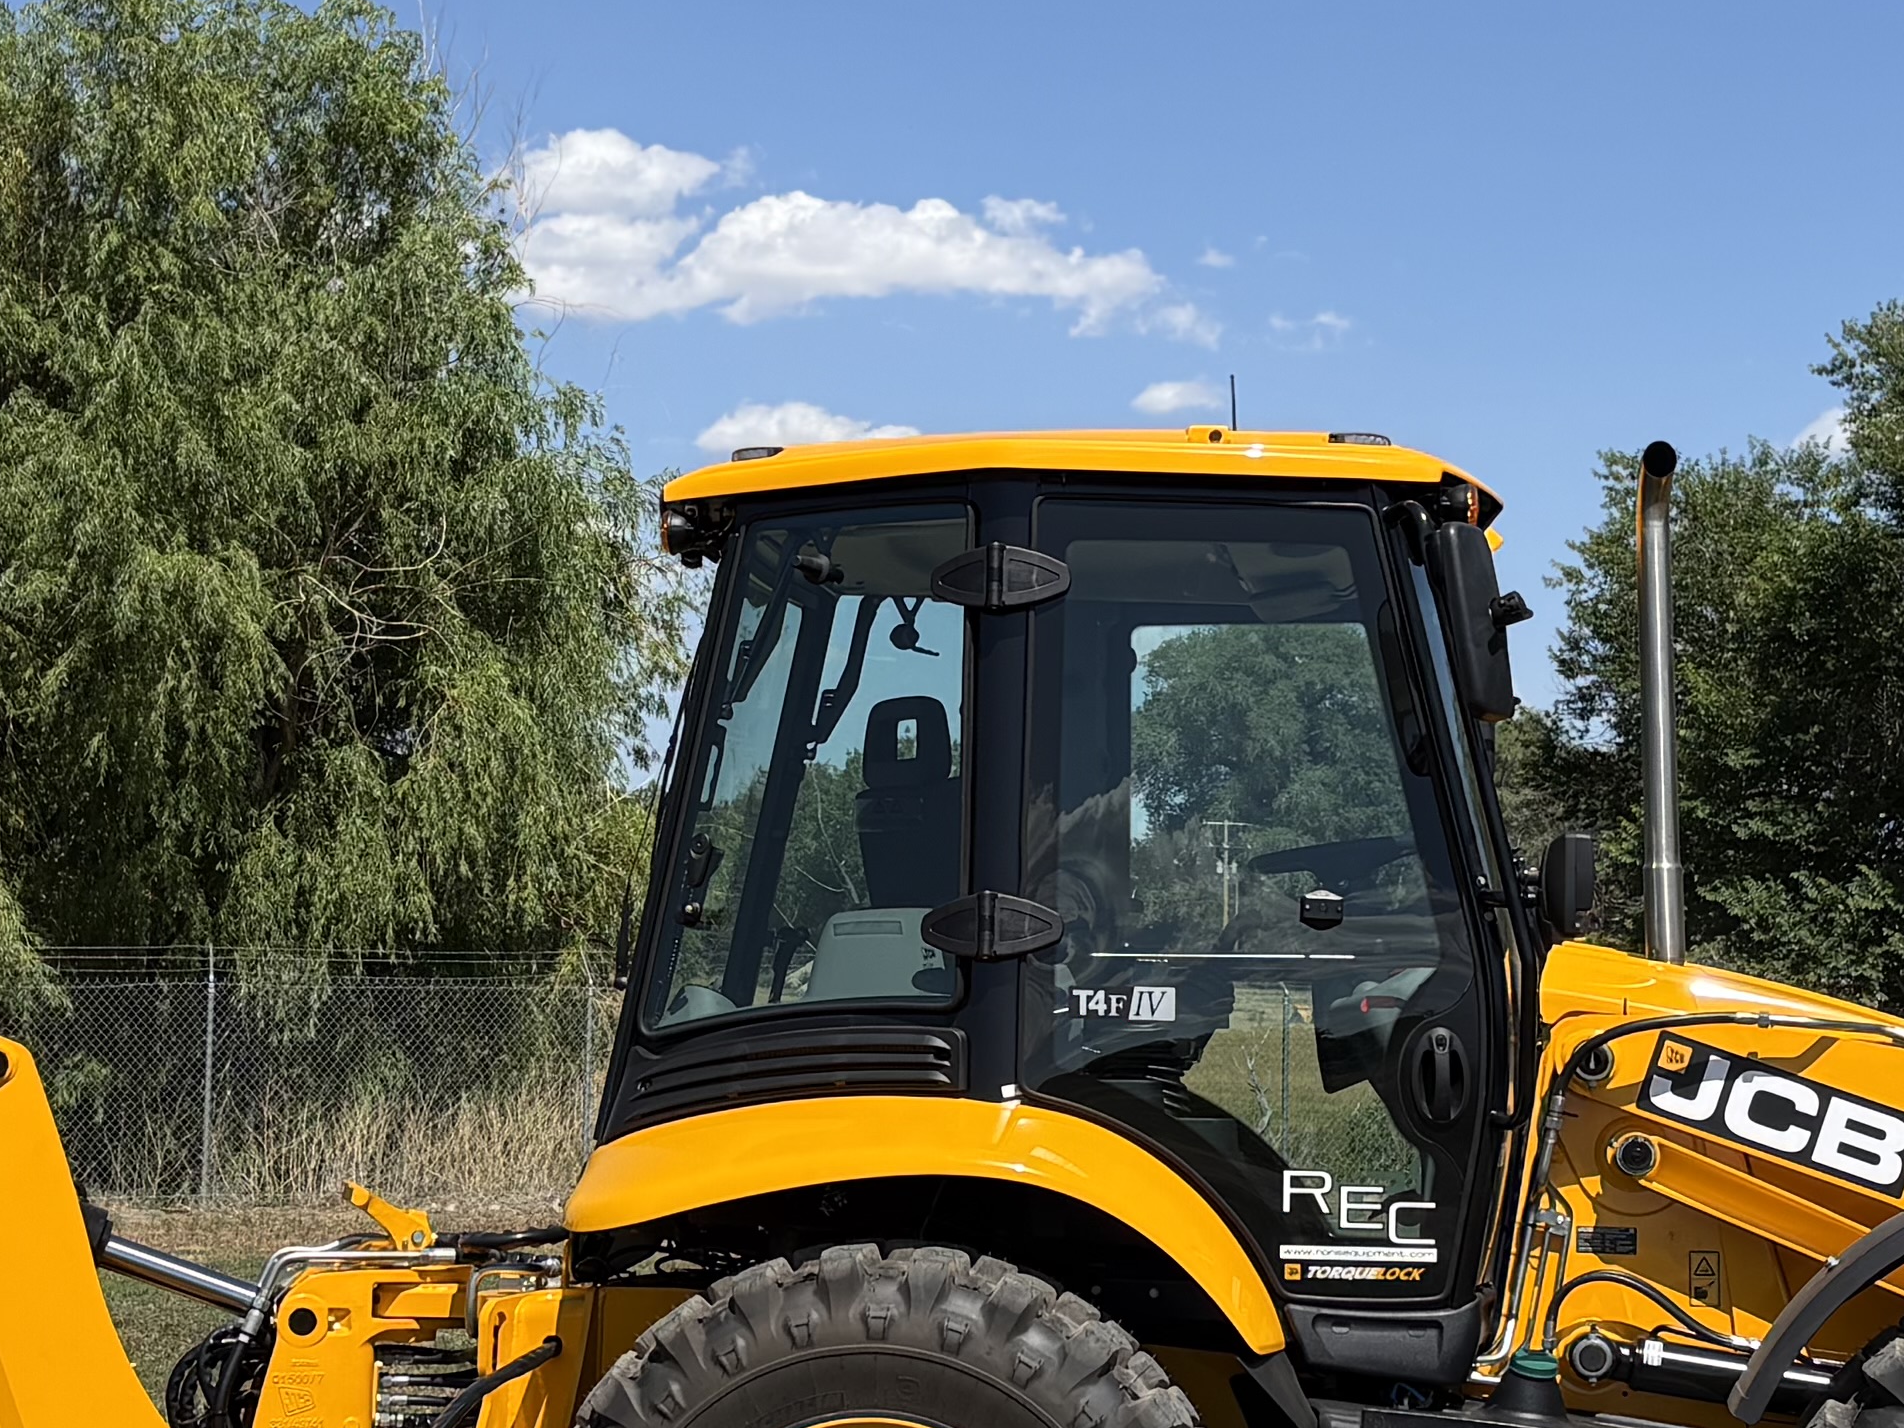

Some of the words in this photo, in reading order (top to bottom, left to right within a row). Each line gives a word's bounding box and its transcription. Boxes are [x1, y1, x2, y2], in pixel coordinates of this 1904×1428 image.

[1072, 989, 1127, 1017] T4F
[1282, 1169, 1437, 1245] REC
[1306, 1265, 1426, 1281] TORQUELOCK
